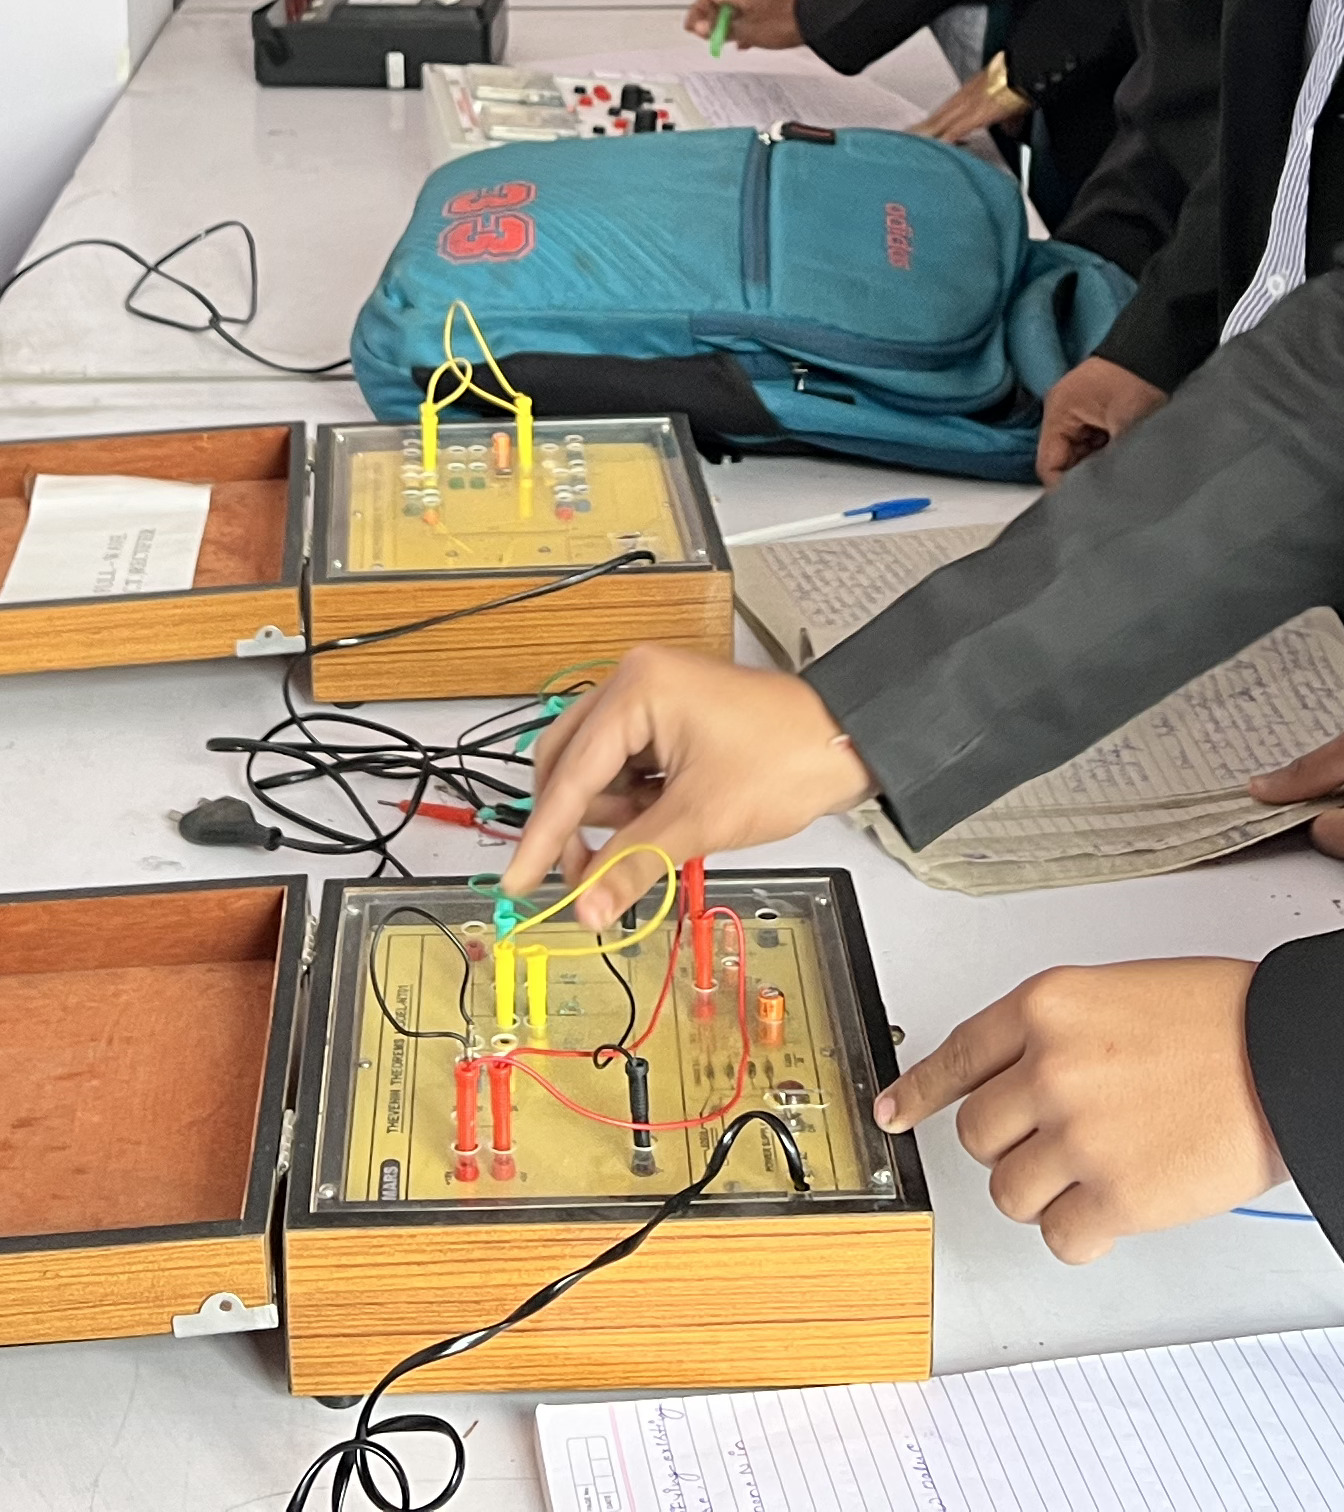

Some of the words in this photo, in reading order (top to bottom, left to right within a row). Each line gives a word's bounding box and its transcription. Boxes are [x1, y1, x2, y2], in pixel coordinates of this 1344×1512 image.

[438, 181, 537, 264] 33
[386, 1089, 402, 1134] THEVENIN
[381, 1165, 400, 1200] MARS
